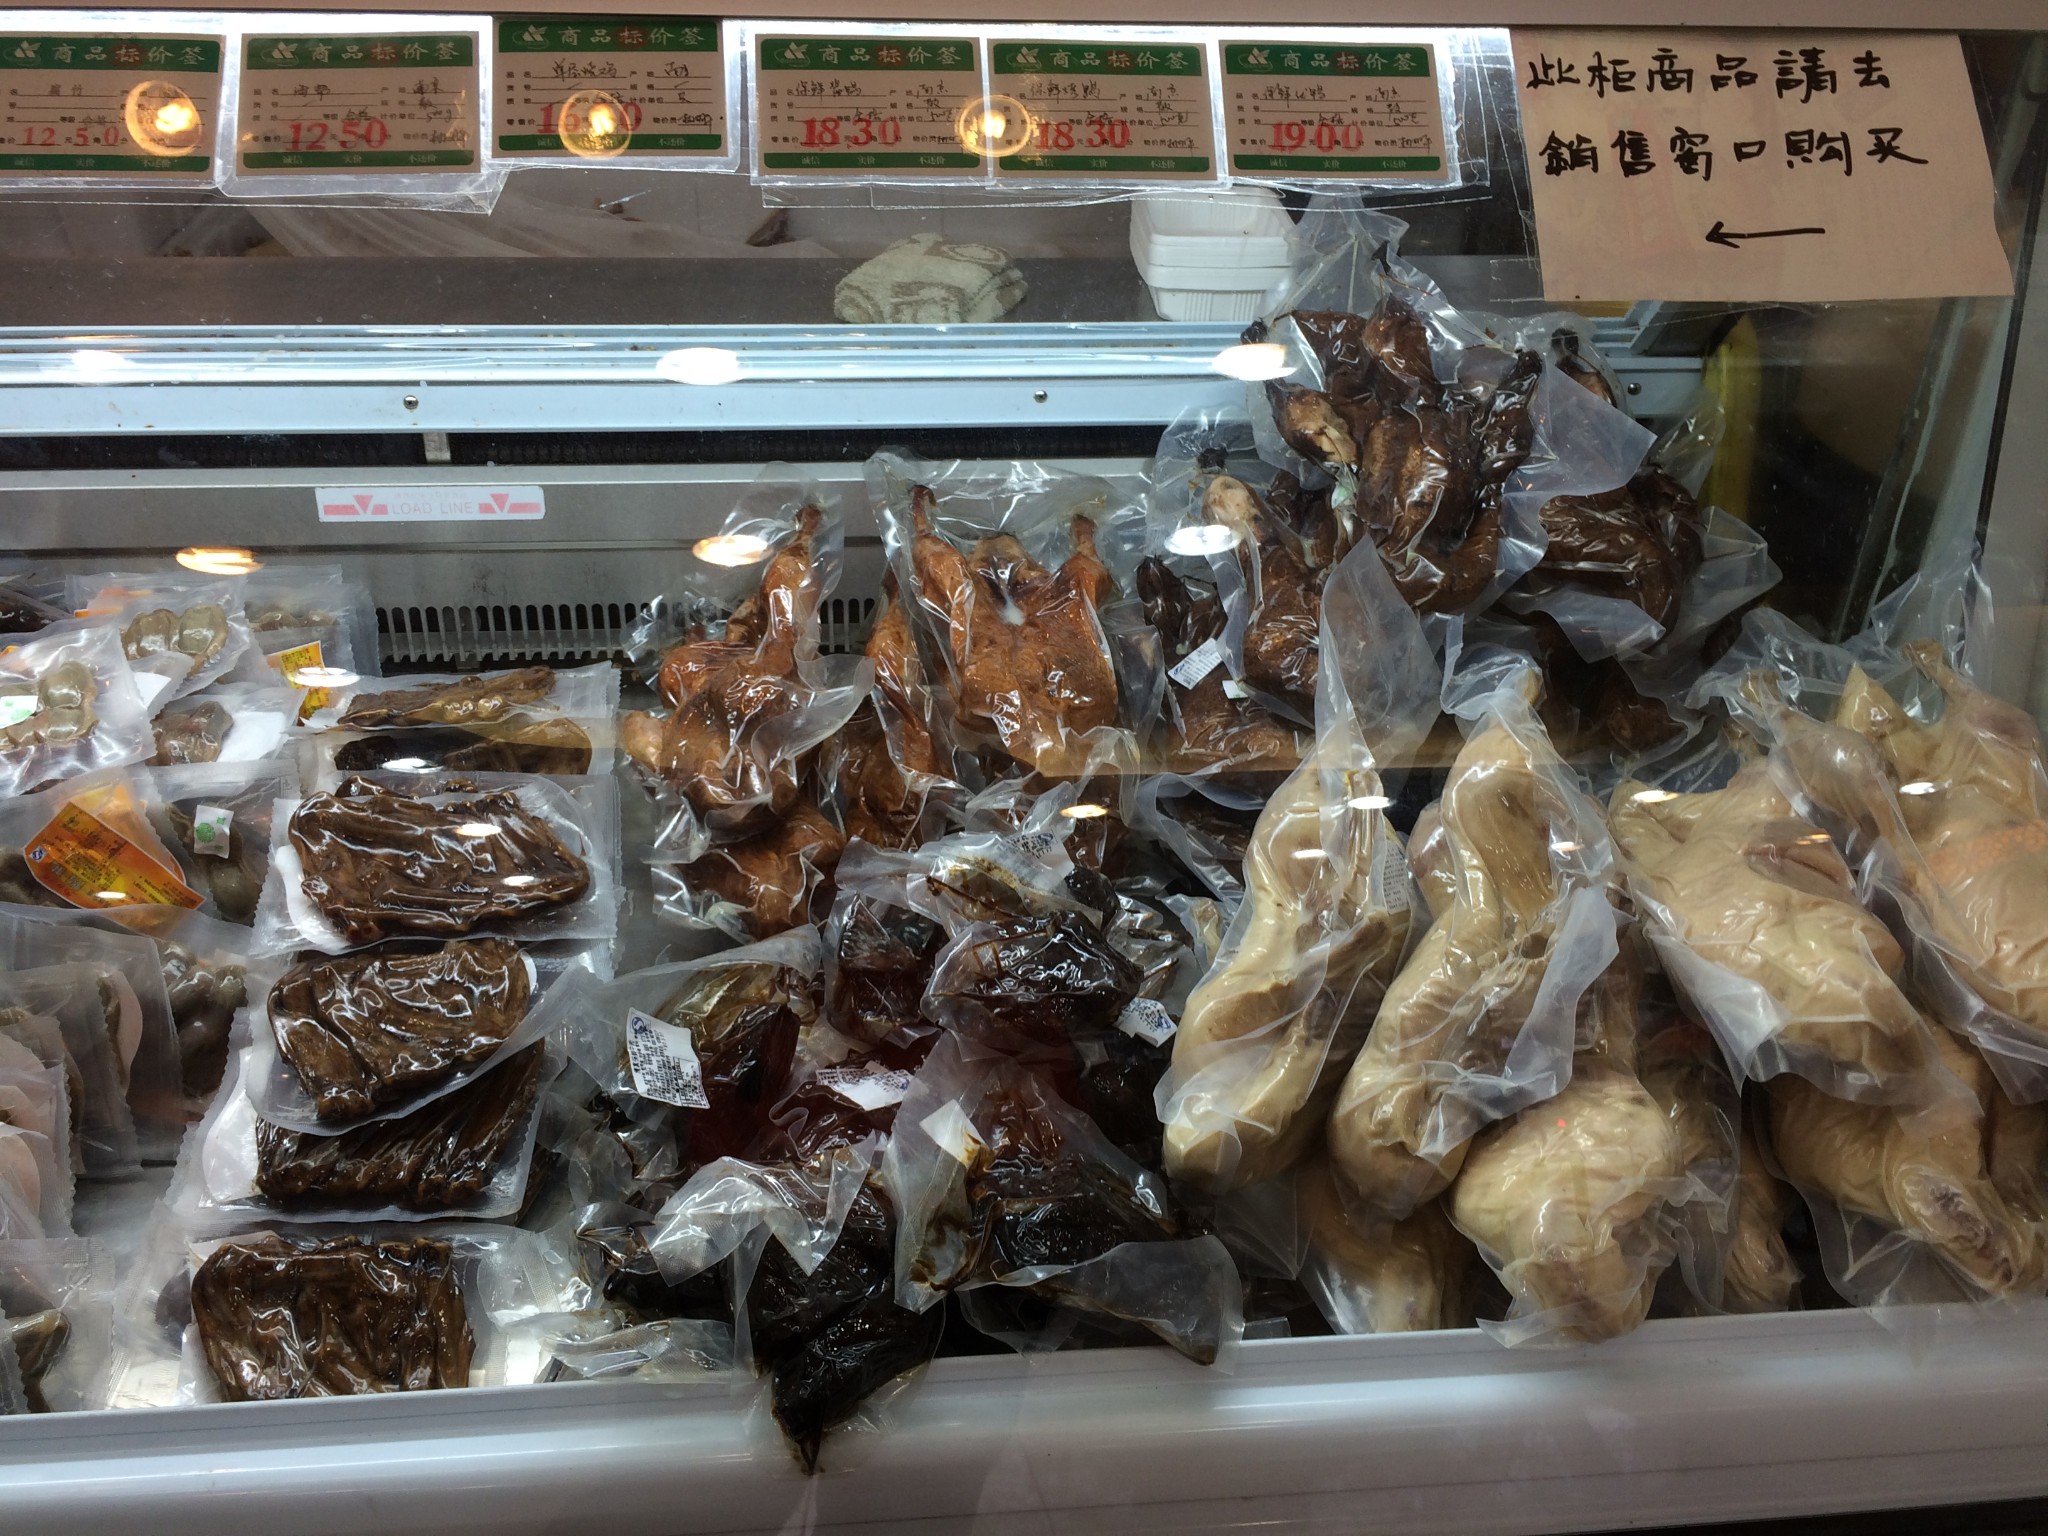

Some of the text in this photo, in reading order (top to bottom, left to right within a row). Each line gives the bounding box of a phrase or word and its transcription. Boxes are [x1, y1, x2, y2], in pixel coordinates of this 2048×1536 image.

[558, 26, 704, 46] 商品标价签
[52, 45, 205, 65] 商品标价签
[312, 42, 460, 63] 商品标价签
[819, 45, 961, 65] 商品标价签
[1050, 49, 1189, 69] 商品标价签
[1281, 50, 1417, 70] 商品标价签
[1526, 48, 1890, 103] 此柜商品請去
[24, 127, 56, 146] 12
[800, 117, 841, 147] 18
[852, 117, 901, 147] 30
[1035, 121, 1075, 151] 18
[1085, 119, 1130, 149] 30
[1270, 121, 1306, 152] 19
[392, 501, 474, 515] LOAD LINE
